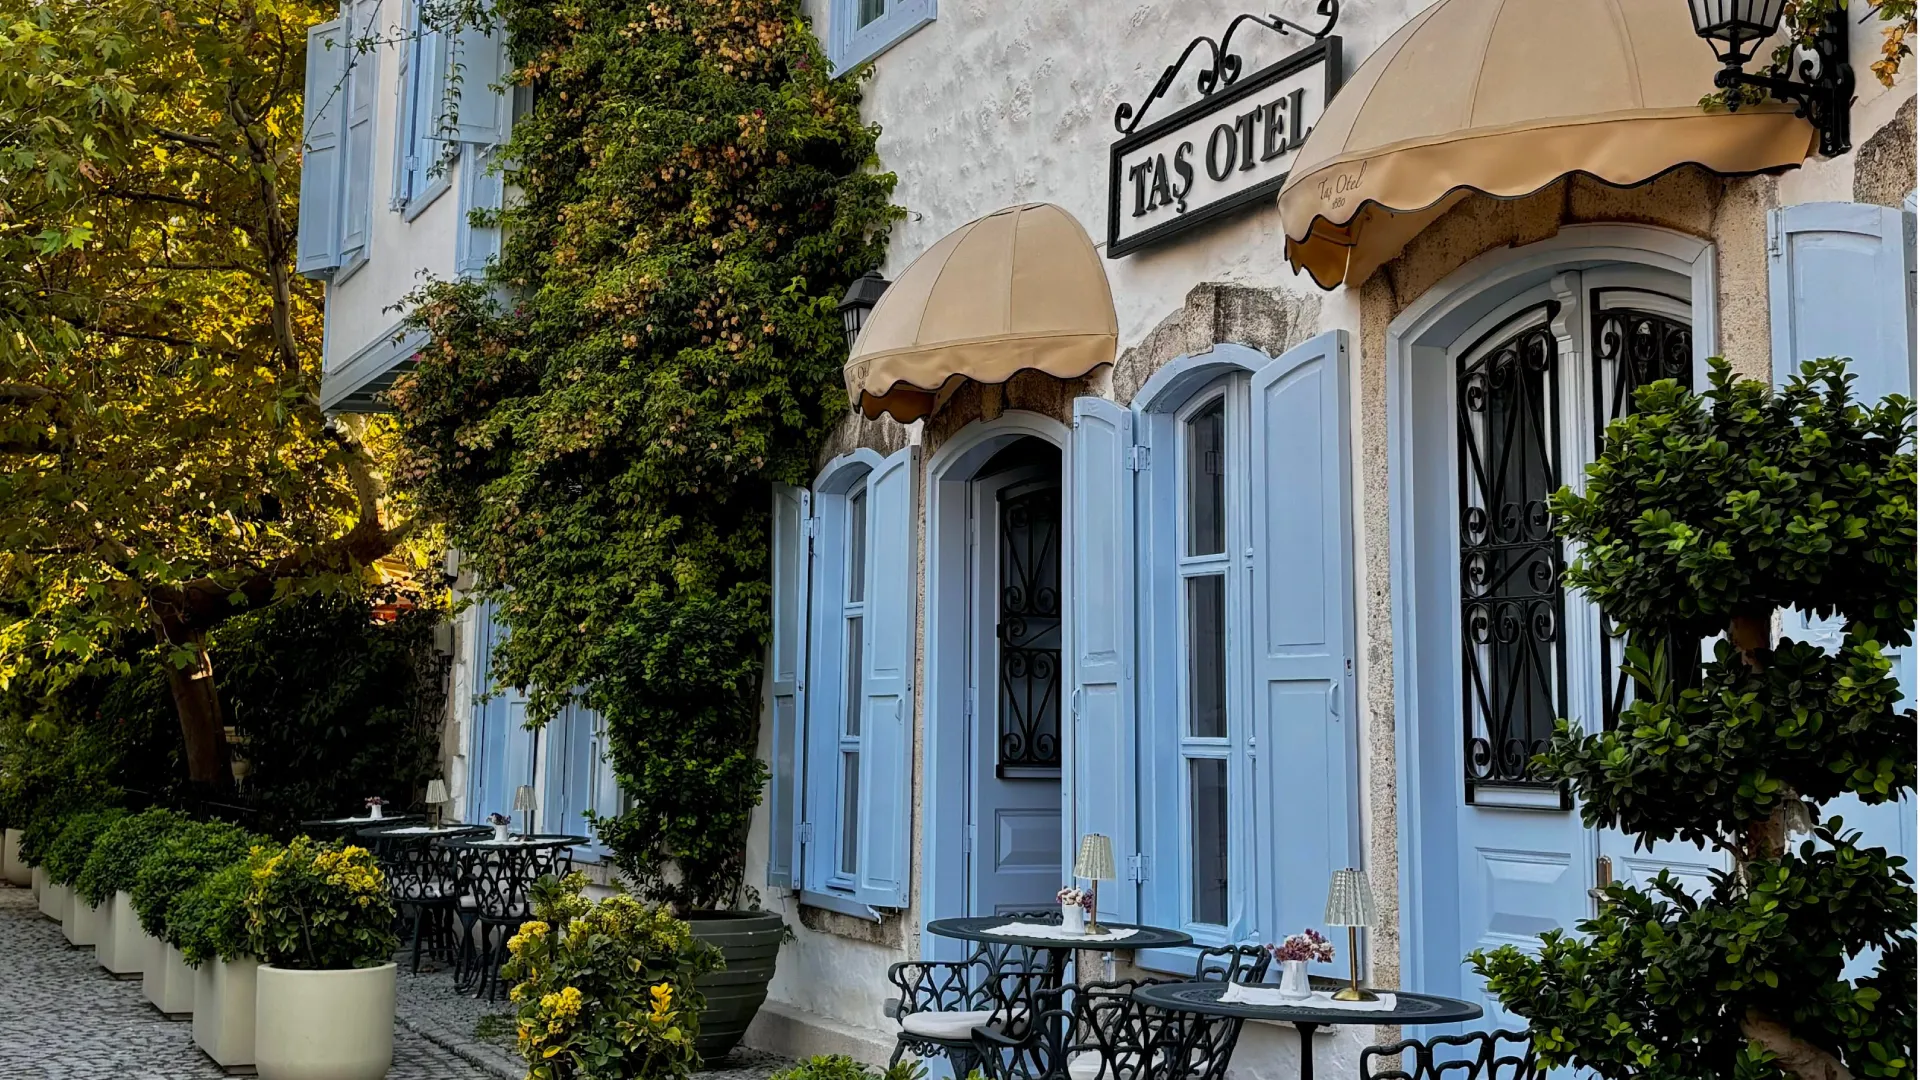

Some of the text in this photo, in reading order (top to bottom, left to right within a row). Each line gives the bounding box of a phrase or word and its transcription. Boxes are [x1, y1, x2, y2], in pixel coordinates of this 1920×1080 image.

[1129, 87, 1312, 217] TAŞ OTEL
[1336, 160, 1367, 194] Otel
